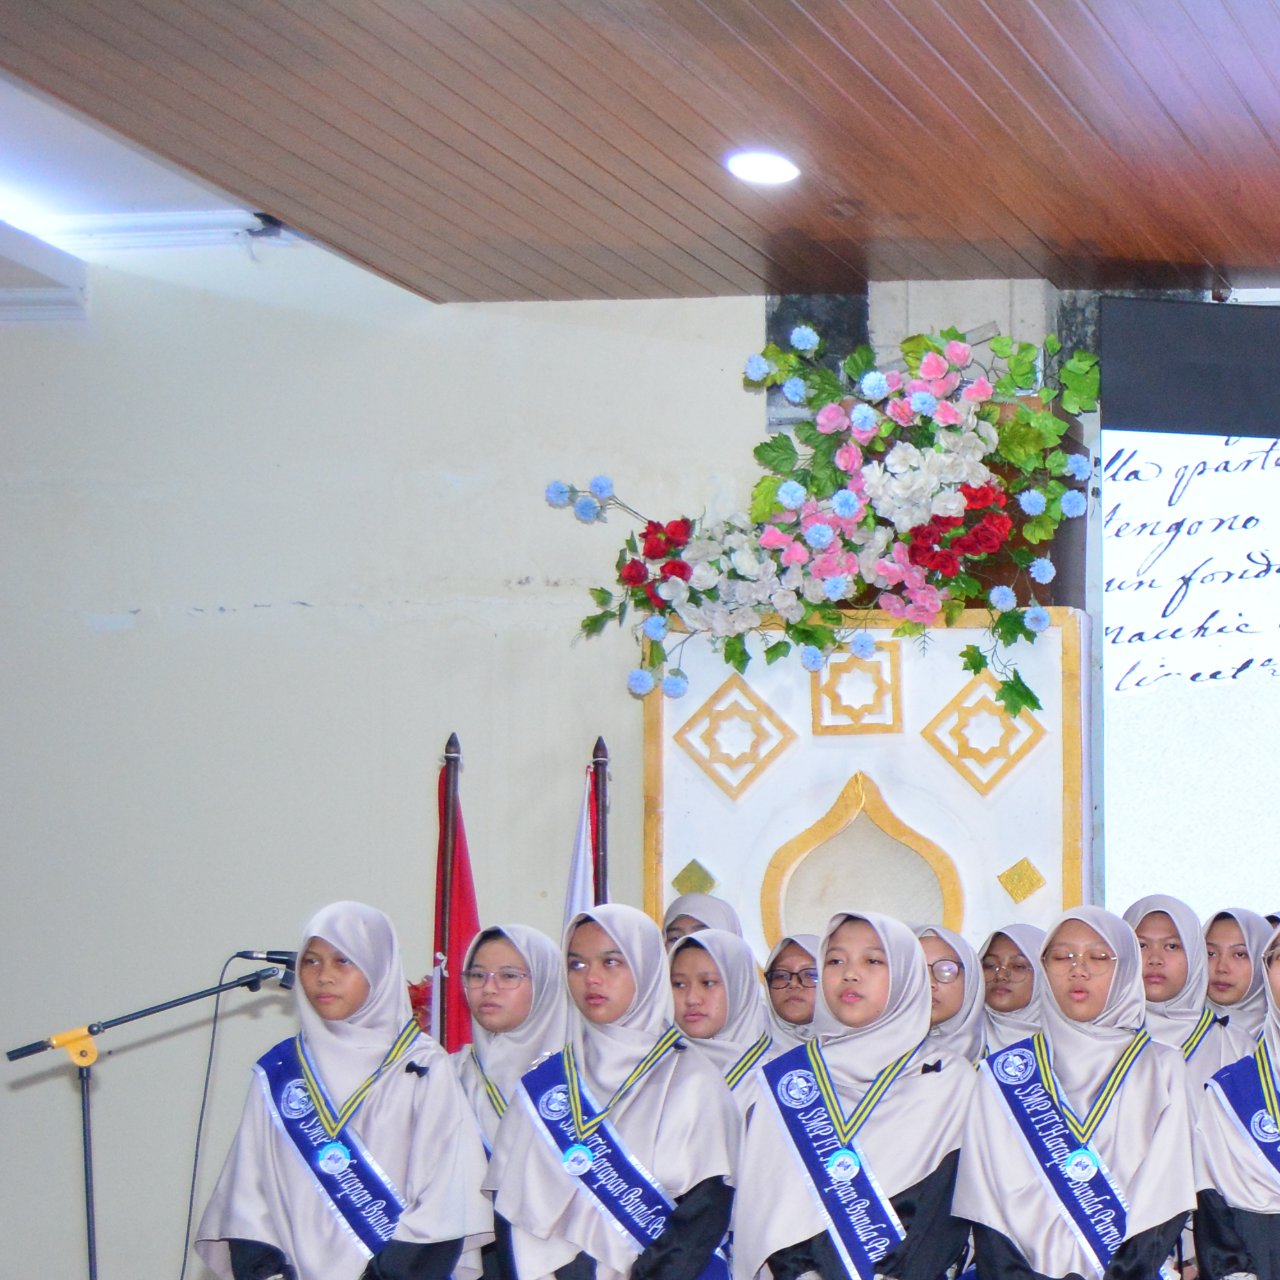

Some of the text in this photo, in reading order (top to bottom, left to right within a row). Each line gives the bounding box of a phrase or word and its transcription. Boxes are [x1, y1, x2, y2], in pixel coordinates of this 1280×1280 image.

[1014, 1082, 1050, 1115] SMP
[1031, 1109, 1063, 1135] IT
[590, 1147, 630, 1198] Harapan
[620, 1187, 662, 1229] Bunda
[797, 1107, 834, 1142] SMP
[846, 1198, 887, 1243] Bunda
